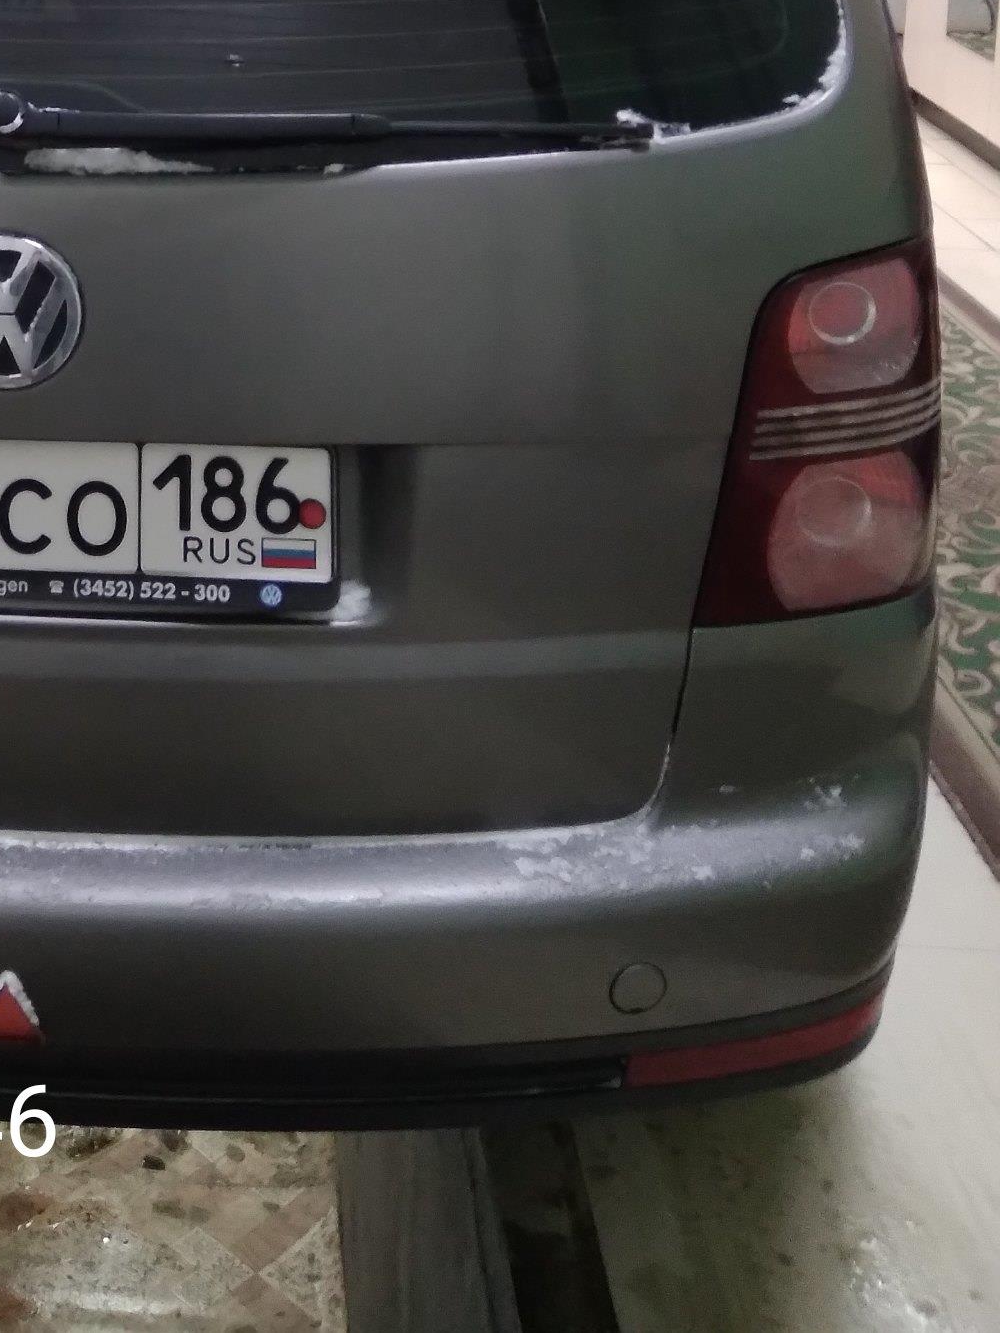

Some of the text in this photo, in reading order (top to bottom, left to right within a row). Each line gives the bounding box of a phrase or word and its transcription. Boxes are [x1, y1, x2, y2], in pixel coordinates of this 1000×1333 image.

[152, 453, 300, 535] 186
[182, 536, 256, 566] RUS
[73, 578, 135, 601] (3452)
[139, 581, 176, 599] 522
[194, 584, 231, 602] 300
